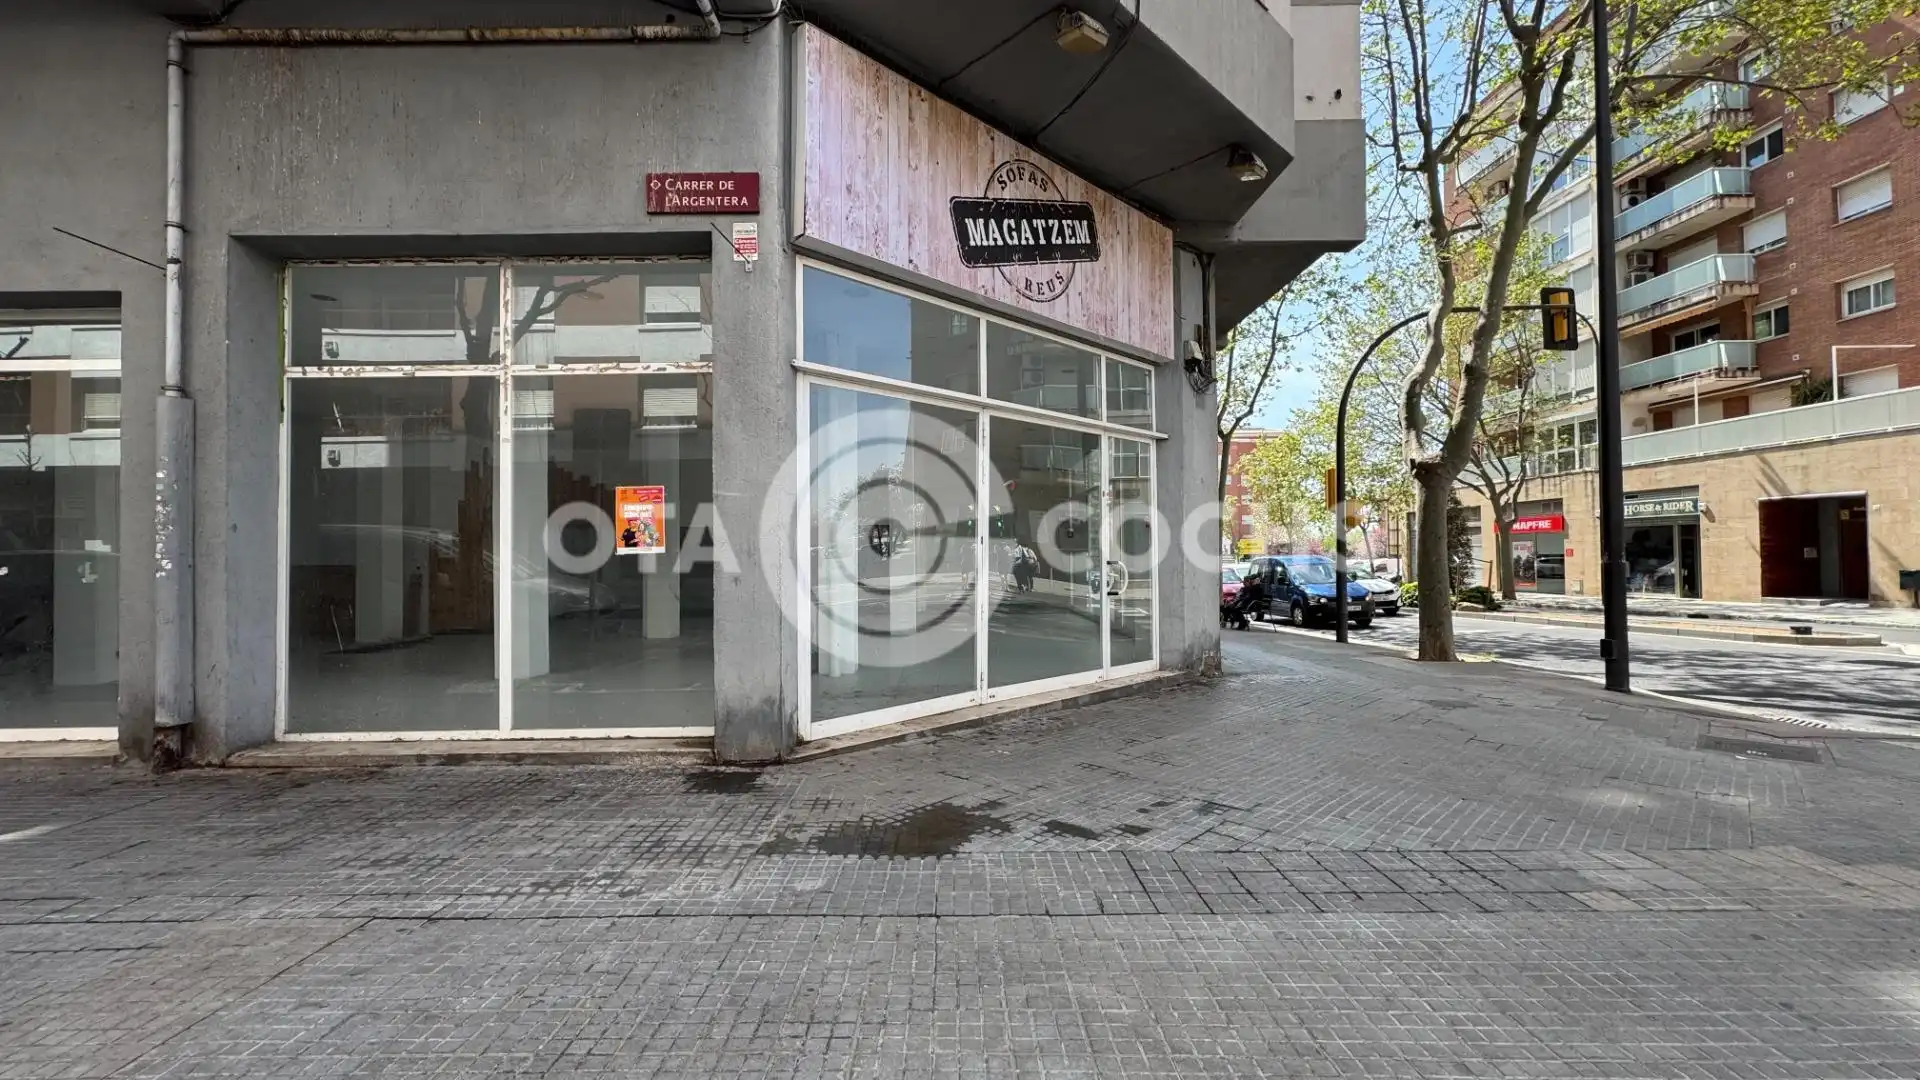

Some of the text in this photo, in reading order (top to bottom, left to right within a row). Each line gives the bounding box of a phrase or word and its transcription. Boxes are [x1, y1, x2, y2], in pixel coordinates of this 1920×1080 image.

[665, 178, 735, 191] CARRER DE
[996, 166, 1049, 193] SOFAS
[965, 218, 1091, 247] MAGATZEM
[1024, 270, 1065, 296] REUS
[1624, 503, 1655, 516] HORSE
[1663, 500, 1695, 512] RIDER
[1512, 519, 1552, 531] MAPFRE
